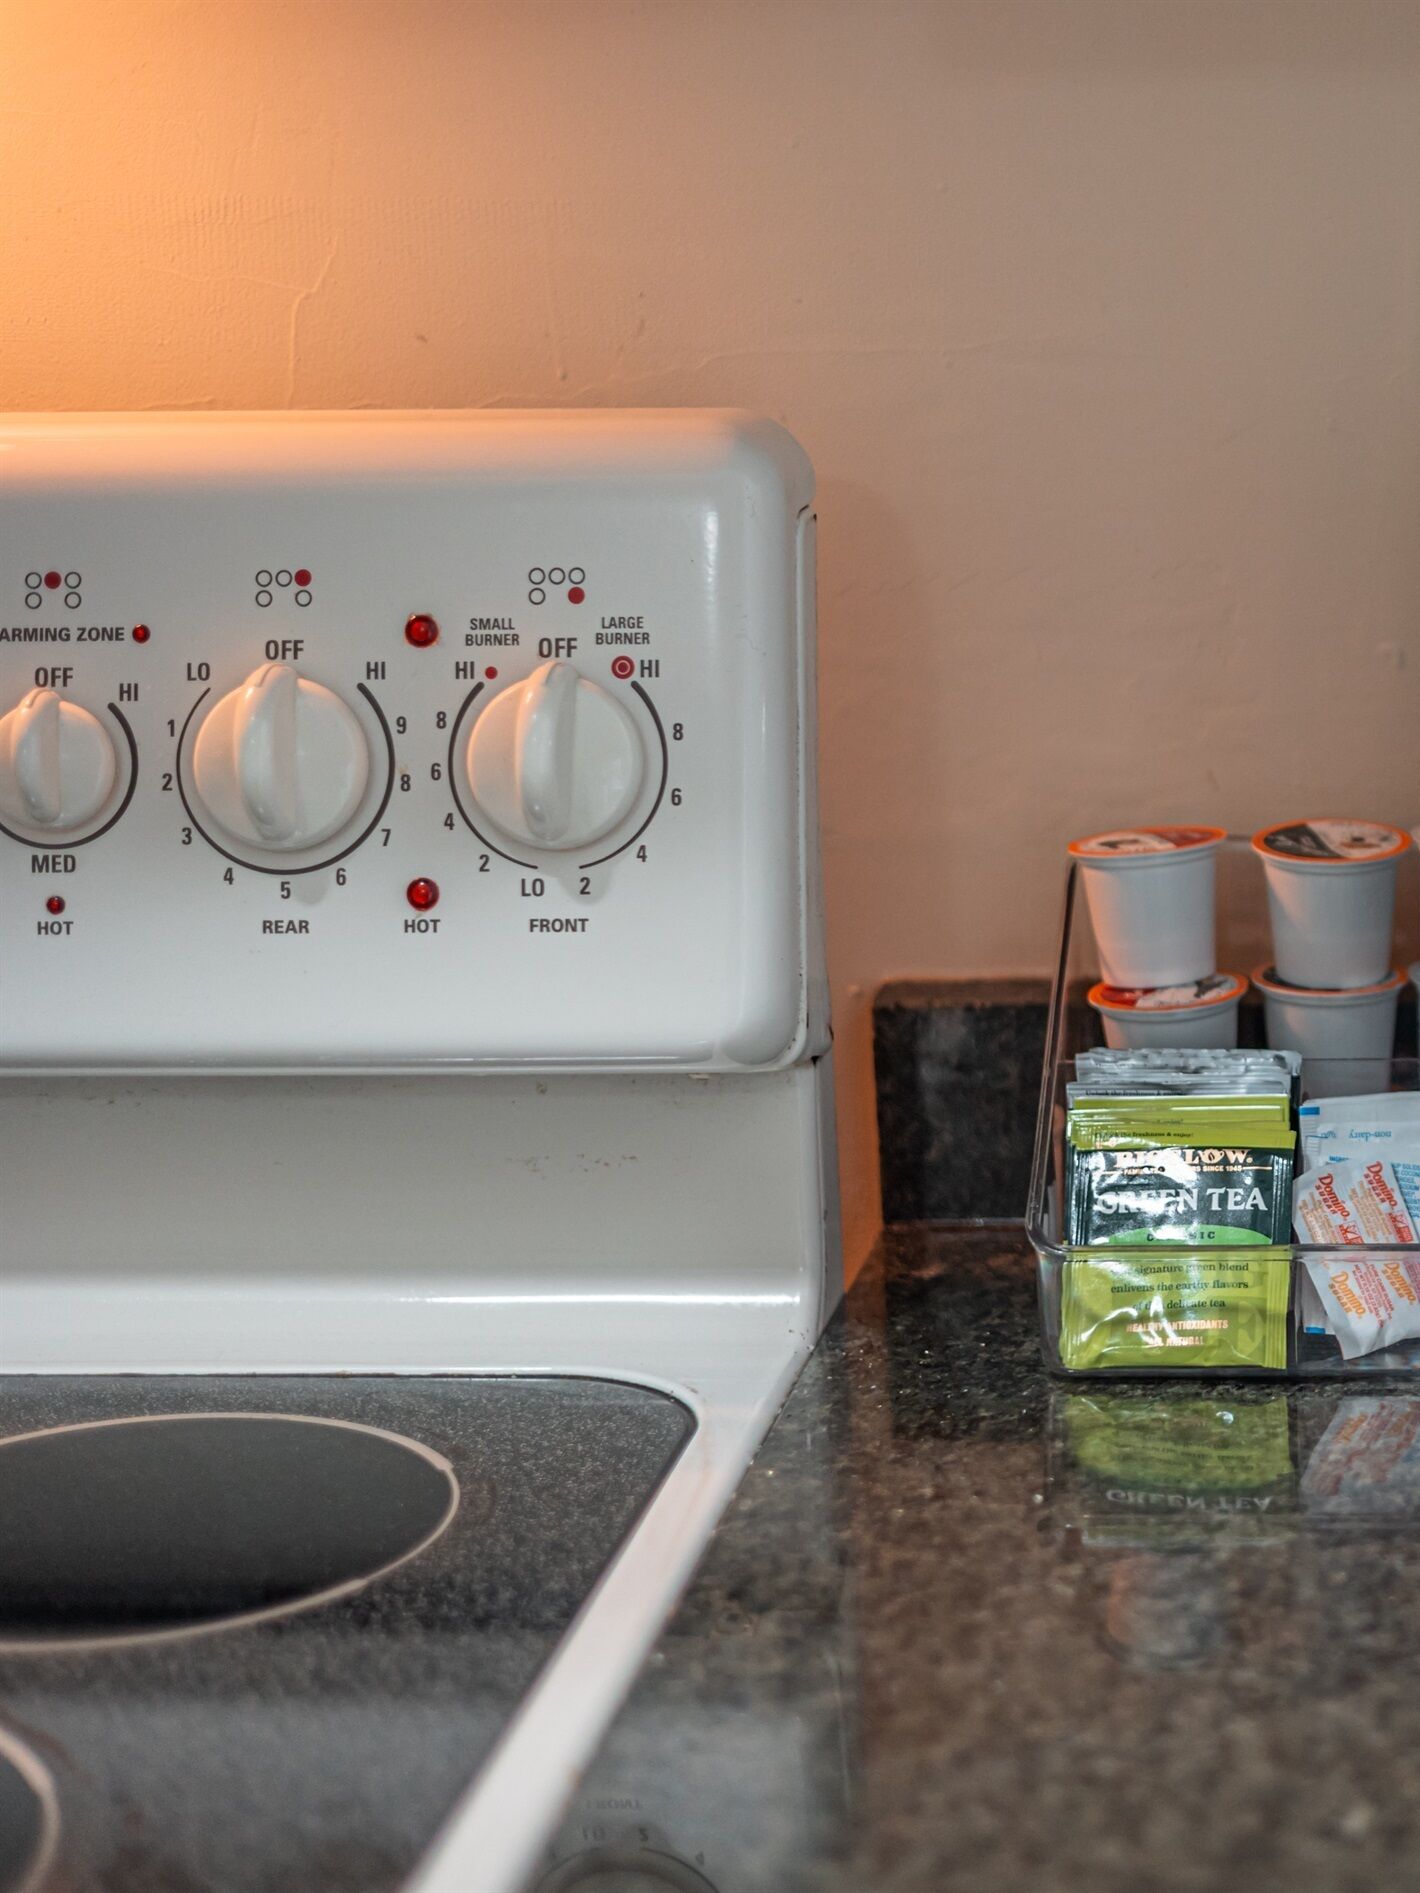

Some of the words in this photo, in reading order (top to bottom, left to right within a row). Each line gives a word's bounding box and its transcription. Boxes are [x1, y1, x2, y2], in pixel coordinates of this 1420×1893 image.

[469, 617, 516, 631] SMALL
[601, 616, 644, 630] LARGE
[0, 627, 71, 642] ARMING
[76, 627, 125, 642] ZONE
[464, 633, 520, 647] BURNER
[595, 632, 650, 646] BURNER
[264, 639, 305, 661] OFF
[538, 637, 578, 659] OFF
[34, 667, 74, 688] OFF
[186, 662, 211, 682] LO
[366, 661, 386, 681] HI
[455, 660, 475, 680] HI
[639, 659, 660, 679] HI
[119, 683, 139, 702] HI
[167, 719, 175, 738] 1
[395, 716, 407, 735] 9
[436, 711, 447, 730] 8
[672, 722, 684, 742] 8
[430, 762, 442, 781] 6
[162, 773, 173, 792] 2
[400, 774, 411, 793] 8
[670, 788, 682, 807] 6
[443, 812, 455, 831] 4
[181, 827, 192, 846] 3
[380, 829, 392, 847] 7
[478, 854, 490, 873] 2
[636, 845, 648, 863] 4
[31, 854, 77, 874] MED
[223, 867, 235, 886] 4
[335, 867, 347, 886] 6
[280, 880, 292, 900] 5
[520, 877, 545, 897] LO
[579, 877, 591, 896] 2
[37, 920, 74, 936] HOT
[262, 919, 310, 935] REAR
[403, 918, 441, 934] HOT
[529, 918, 590, 933] FRONT
[1206, 1186, 1268, 1211] TEA
[1146, 1231, 1216, 1242] CSIC
[1134, 1264, 1184, 1276] signature
[1218, 1262, 1249, 1272] blend
[1110, 1284, 1155, 1294] enlivens
[1156, 1282, 1174, 1292] the
[1212, 1279, 1249, 1290] flavors
[1209, 1300, 1226, 1308] tea
